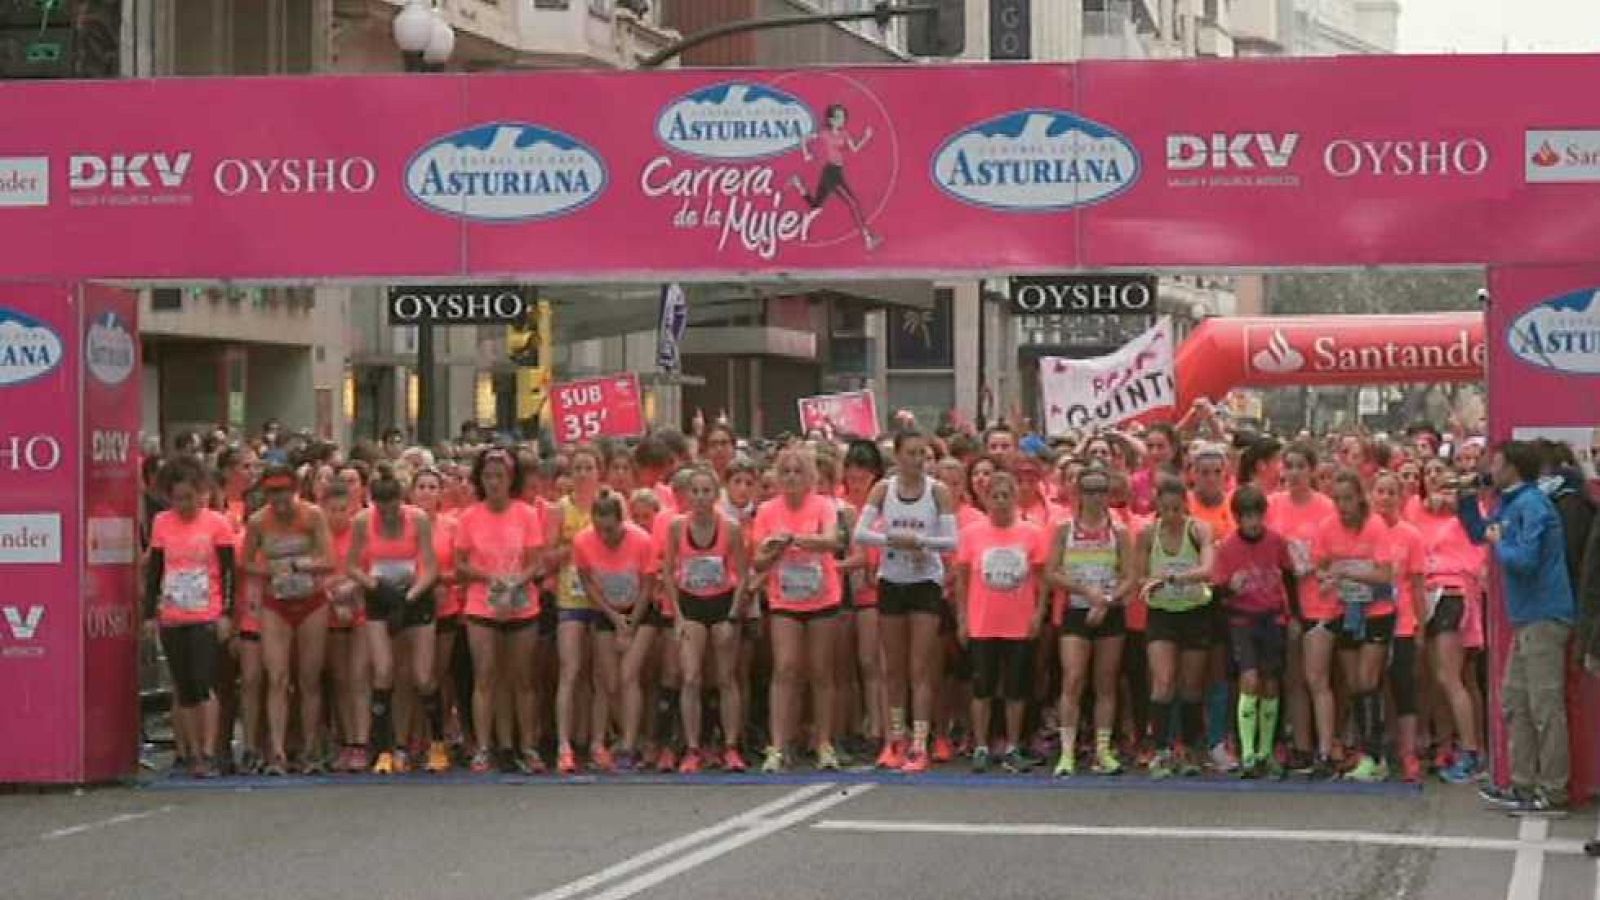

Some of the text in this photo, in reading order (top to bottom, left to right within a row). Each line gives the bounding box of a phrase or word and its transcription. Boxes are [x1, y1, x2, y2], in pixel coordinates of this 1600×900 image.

[669, 111, 802, 142] ASTURIANA
[948, 148, 1122, 186] ASTURIANA
[1166, 133, 1299, 170] DKV
[1324, 139, 1488, 177] OYSHO
[70, 153, 192, 189] DKV
[213, 156, 375, 197] OYSHO
[420, 159, 592, 196] ASTURIANA
[641, 157, 774, 197] Carrera
[674, 192, 824, 258] de la Mujer
[394, 293, 522, 319] OYSHO
[1018, 283, 1150, 310] OYSHO
[561, 384, 603, 409] SUB
